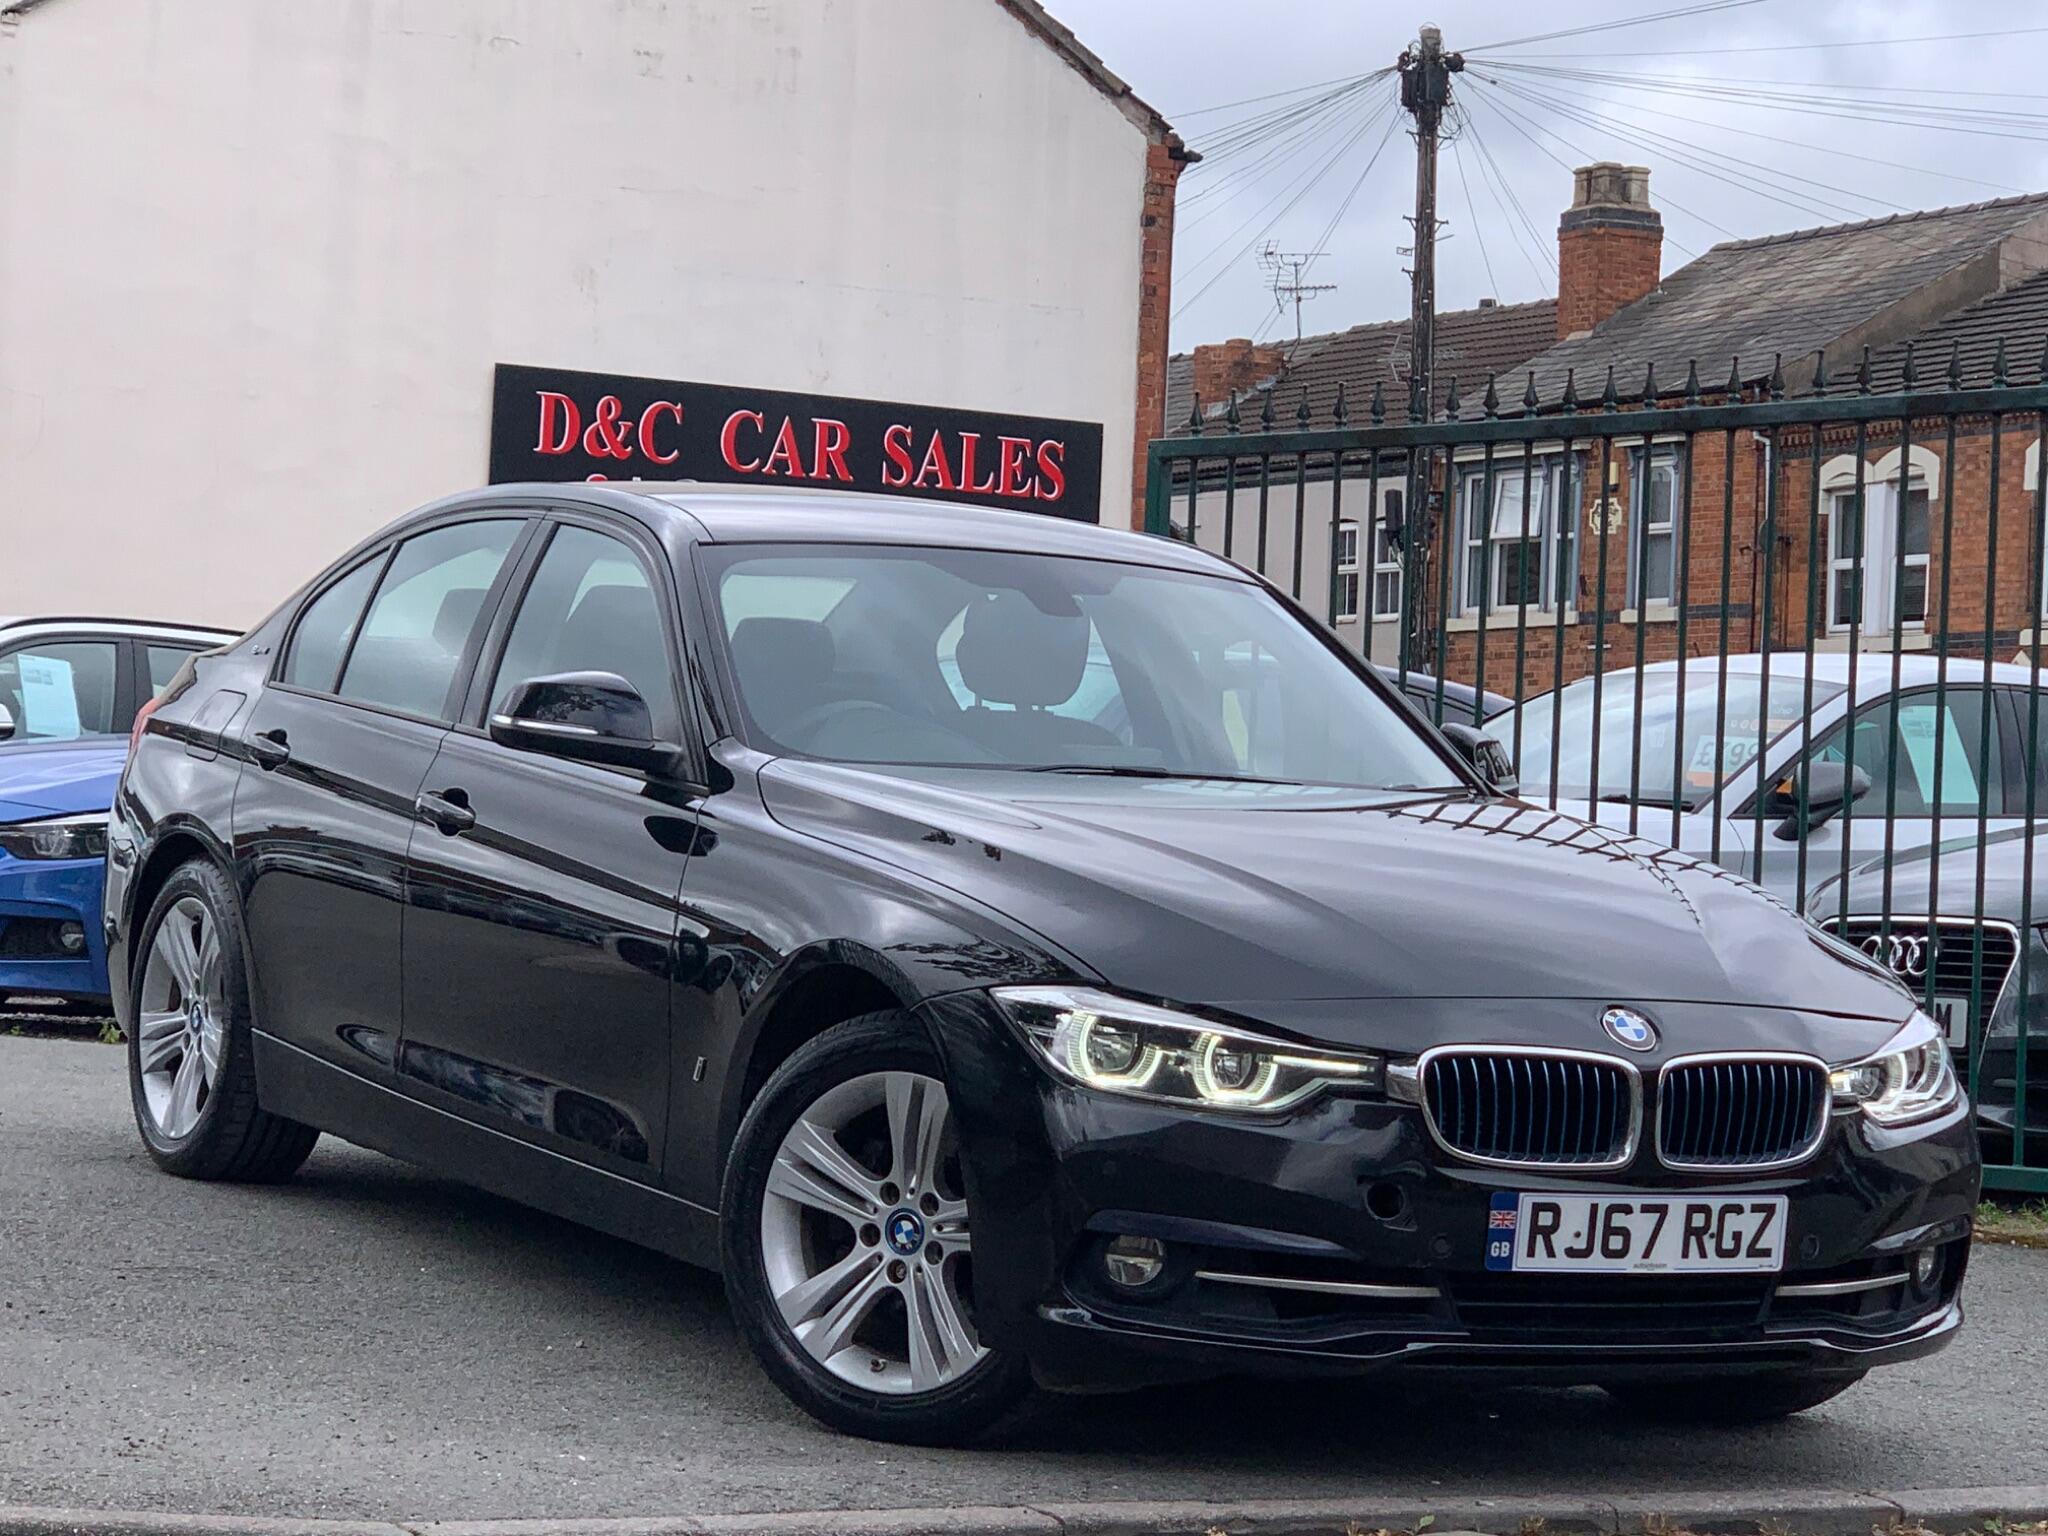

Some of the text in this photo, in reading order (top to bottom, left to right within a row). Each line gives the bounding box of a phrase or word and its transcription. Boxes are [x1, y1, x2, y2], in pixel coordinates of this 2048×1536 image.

[532, 390, 1066, 501] D&C CAR SALES
[1490, 1241, 1510, 1257] GB
[1526, 1202, 1777, 1259] RJ67 RGZ
